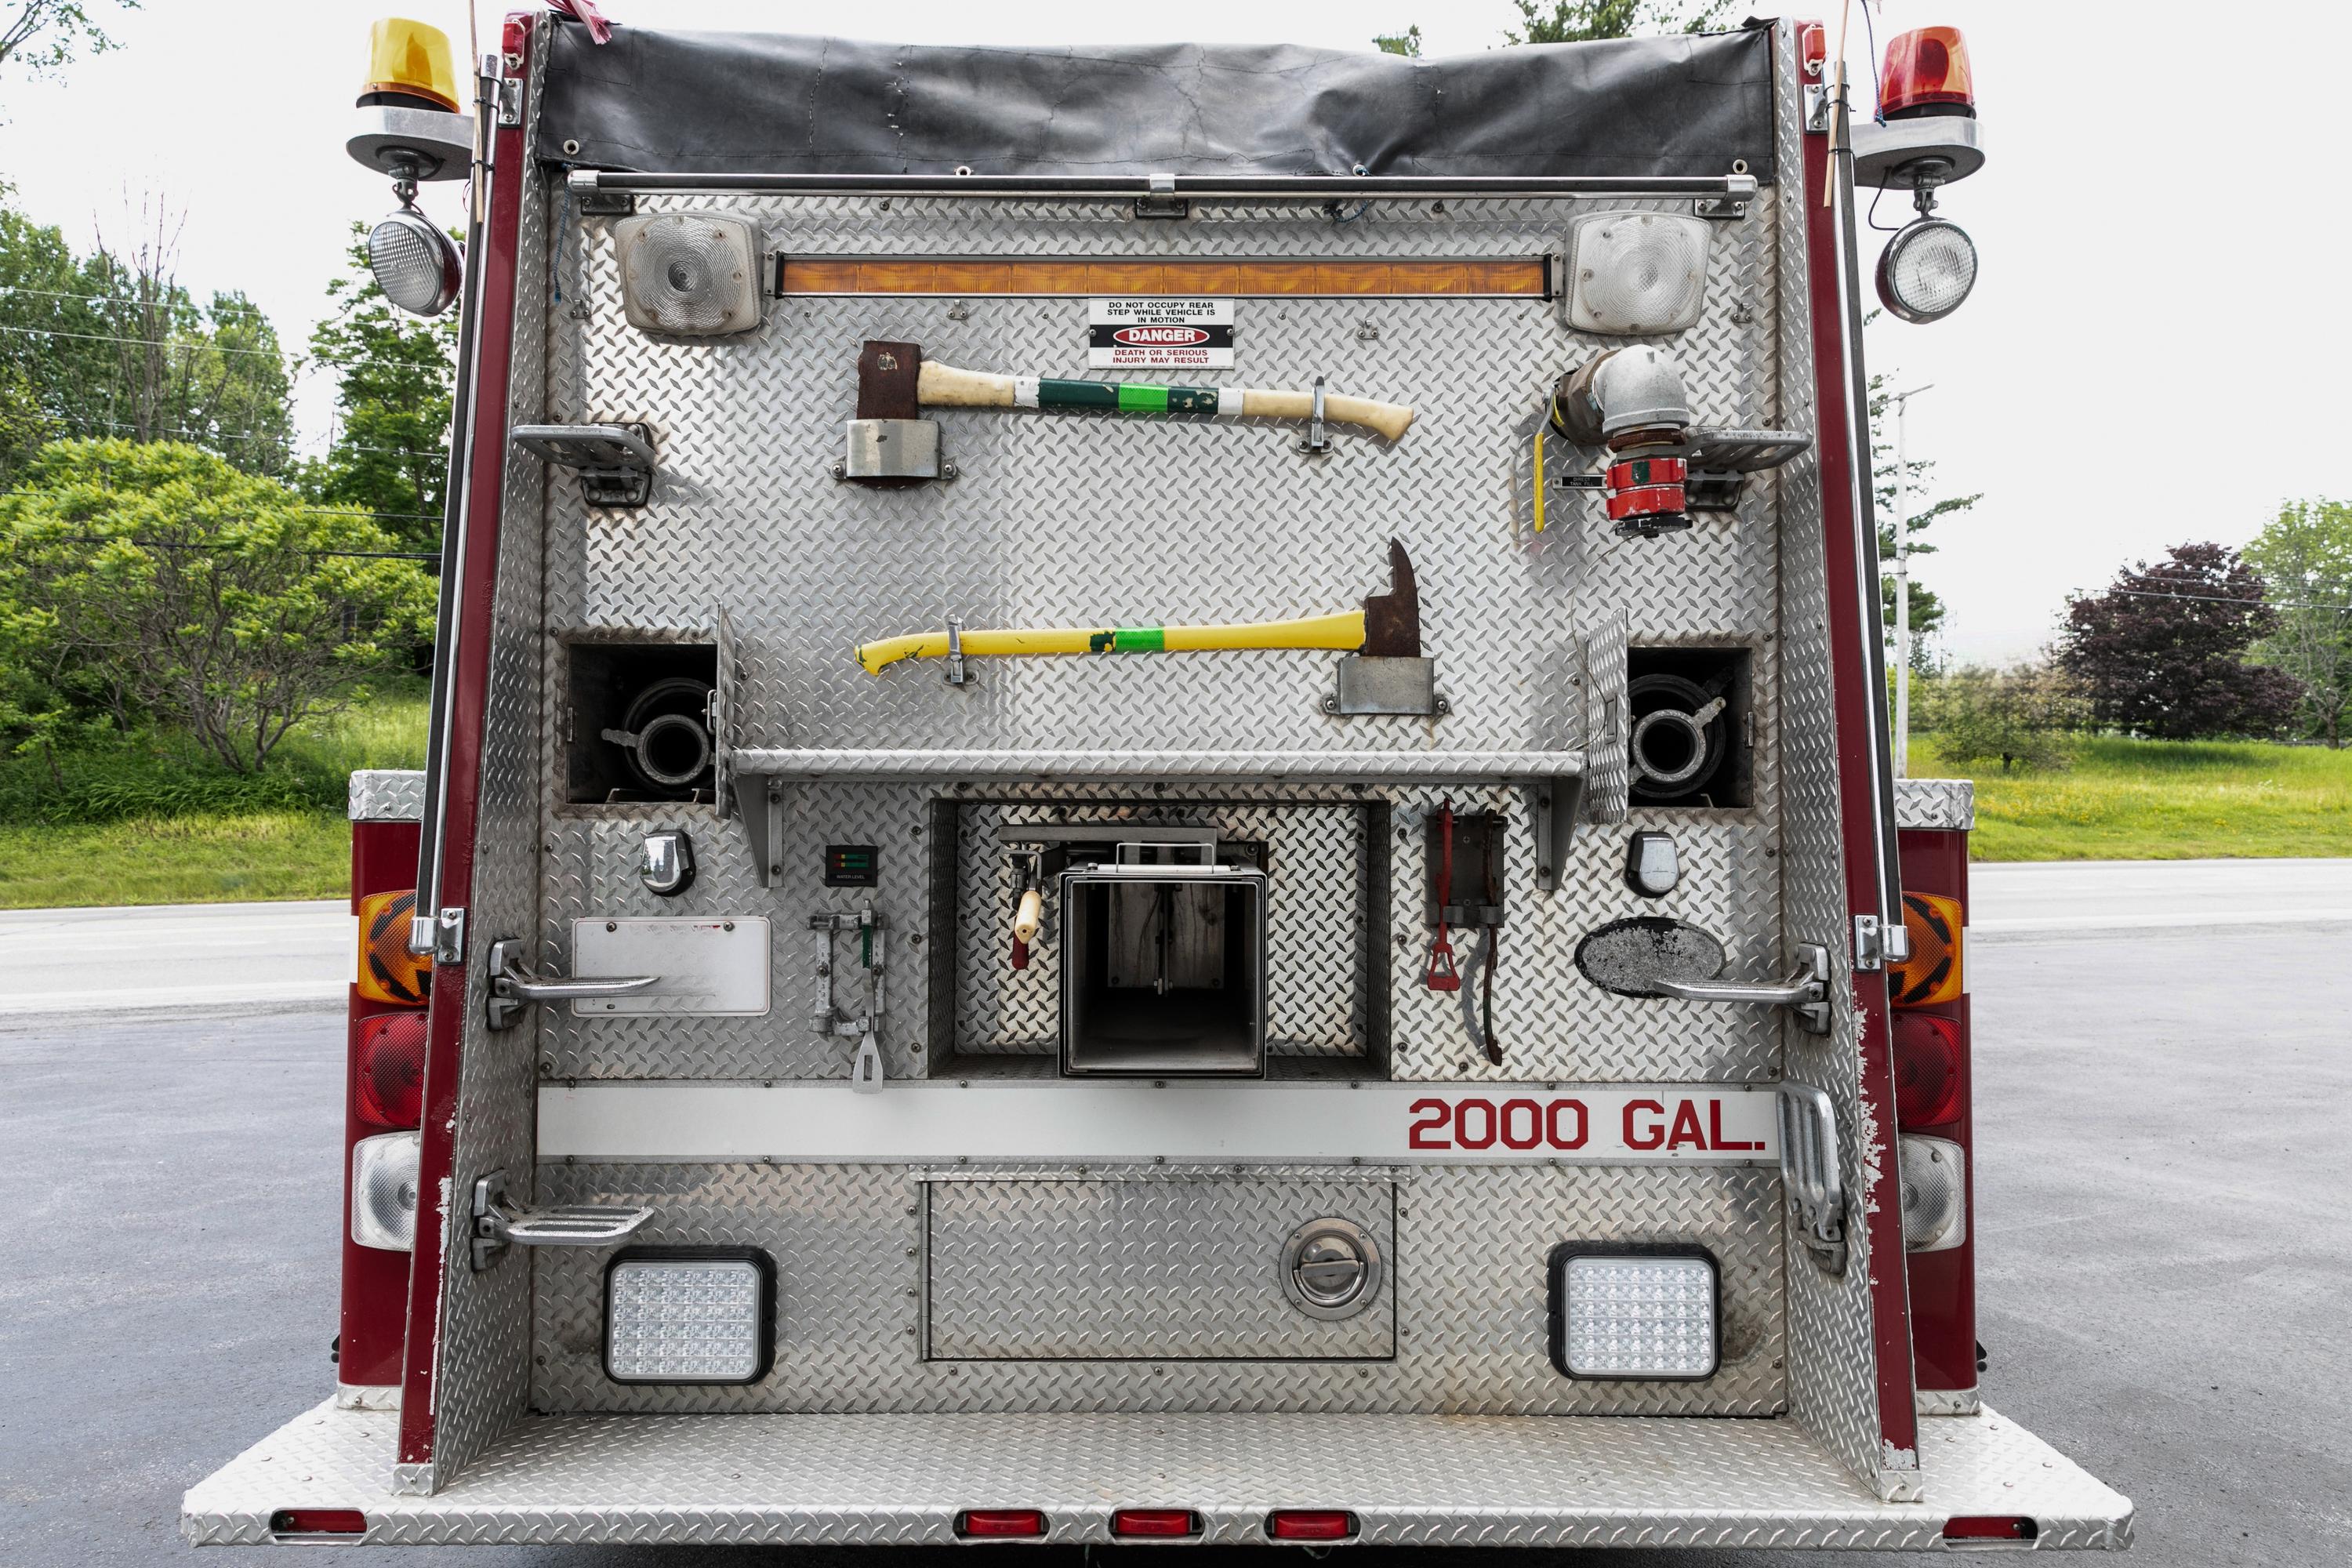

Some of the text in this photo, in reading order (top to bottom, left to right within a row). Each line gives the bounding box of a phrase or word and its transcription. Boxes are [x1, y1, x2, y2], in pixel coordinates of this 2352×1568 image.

[1129, 329, 1196, 342] DANGER
[1409, 1098, 1766, 1150] 2000 GAL.
